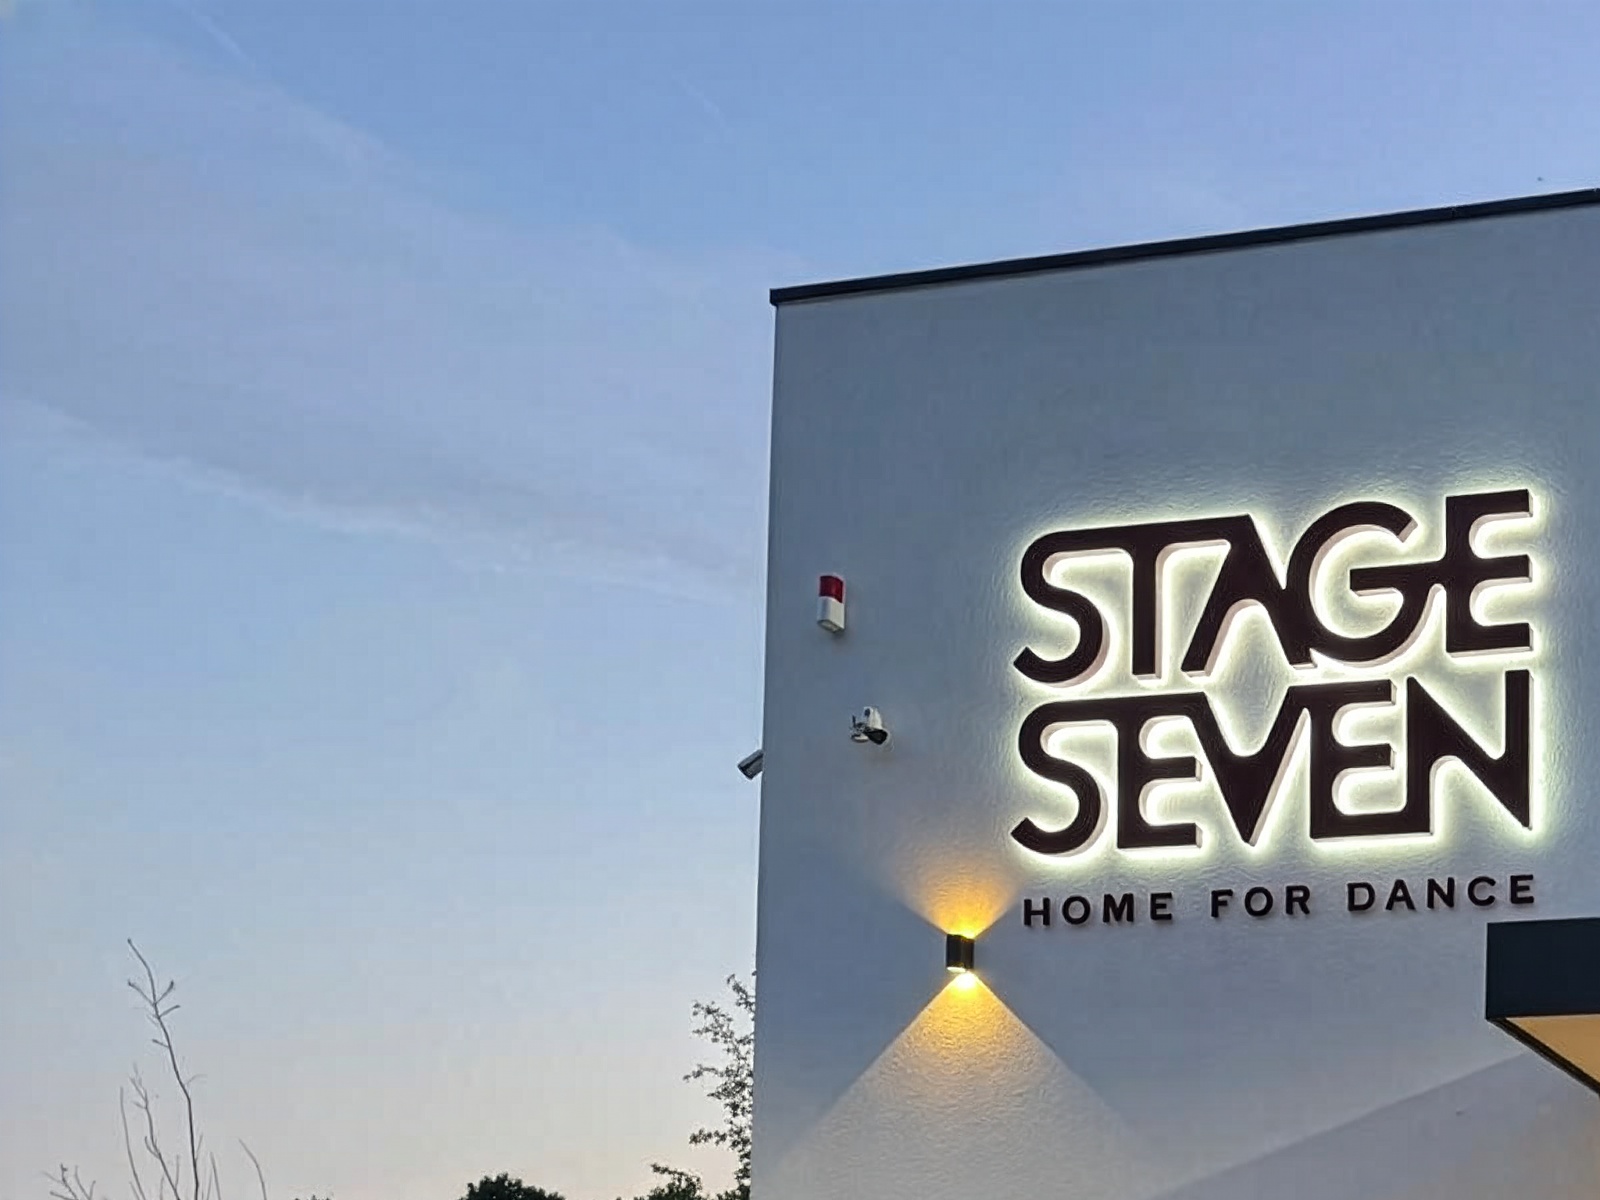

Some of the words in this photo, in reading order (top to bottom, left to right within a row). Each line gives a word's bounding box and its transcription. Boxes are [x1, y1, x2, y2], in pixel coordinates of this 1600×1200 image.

[1013, 488, 1533, 687] STAGE
[1011, 669, 1532, 857] SEVEN
[1022, 891, 1174, 927] HOME
[1210, 885, 1312, 919] FOR
[1347, 874, 1536, 912] DANCE
